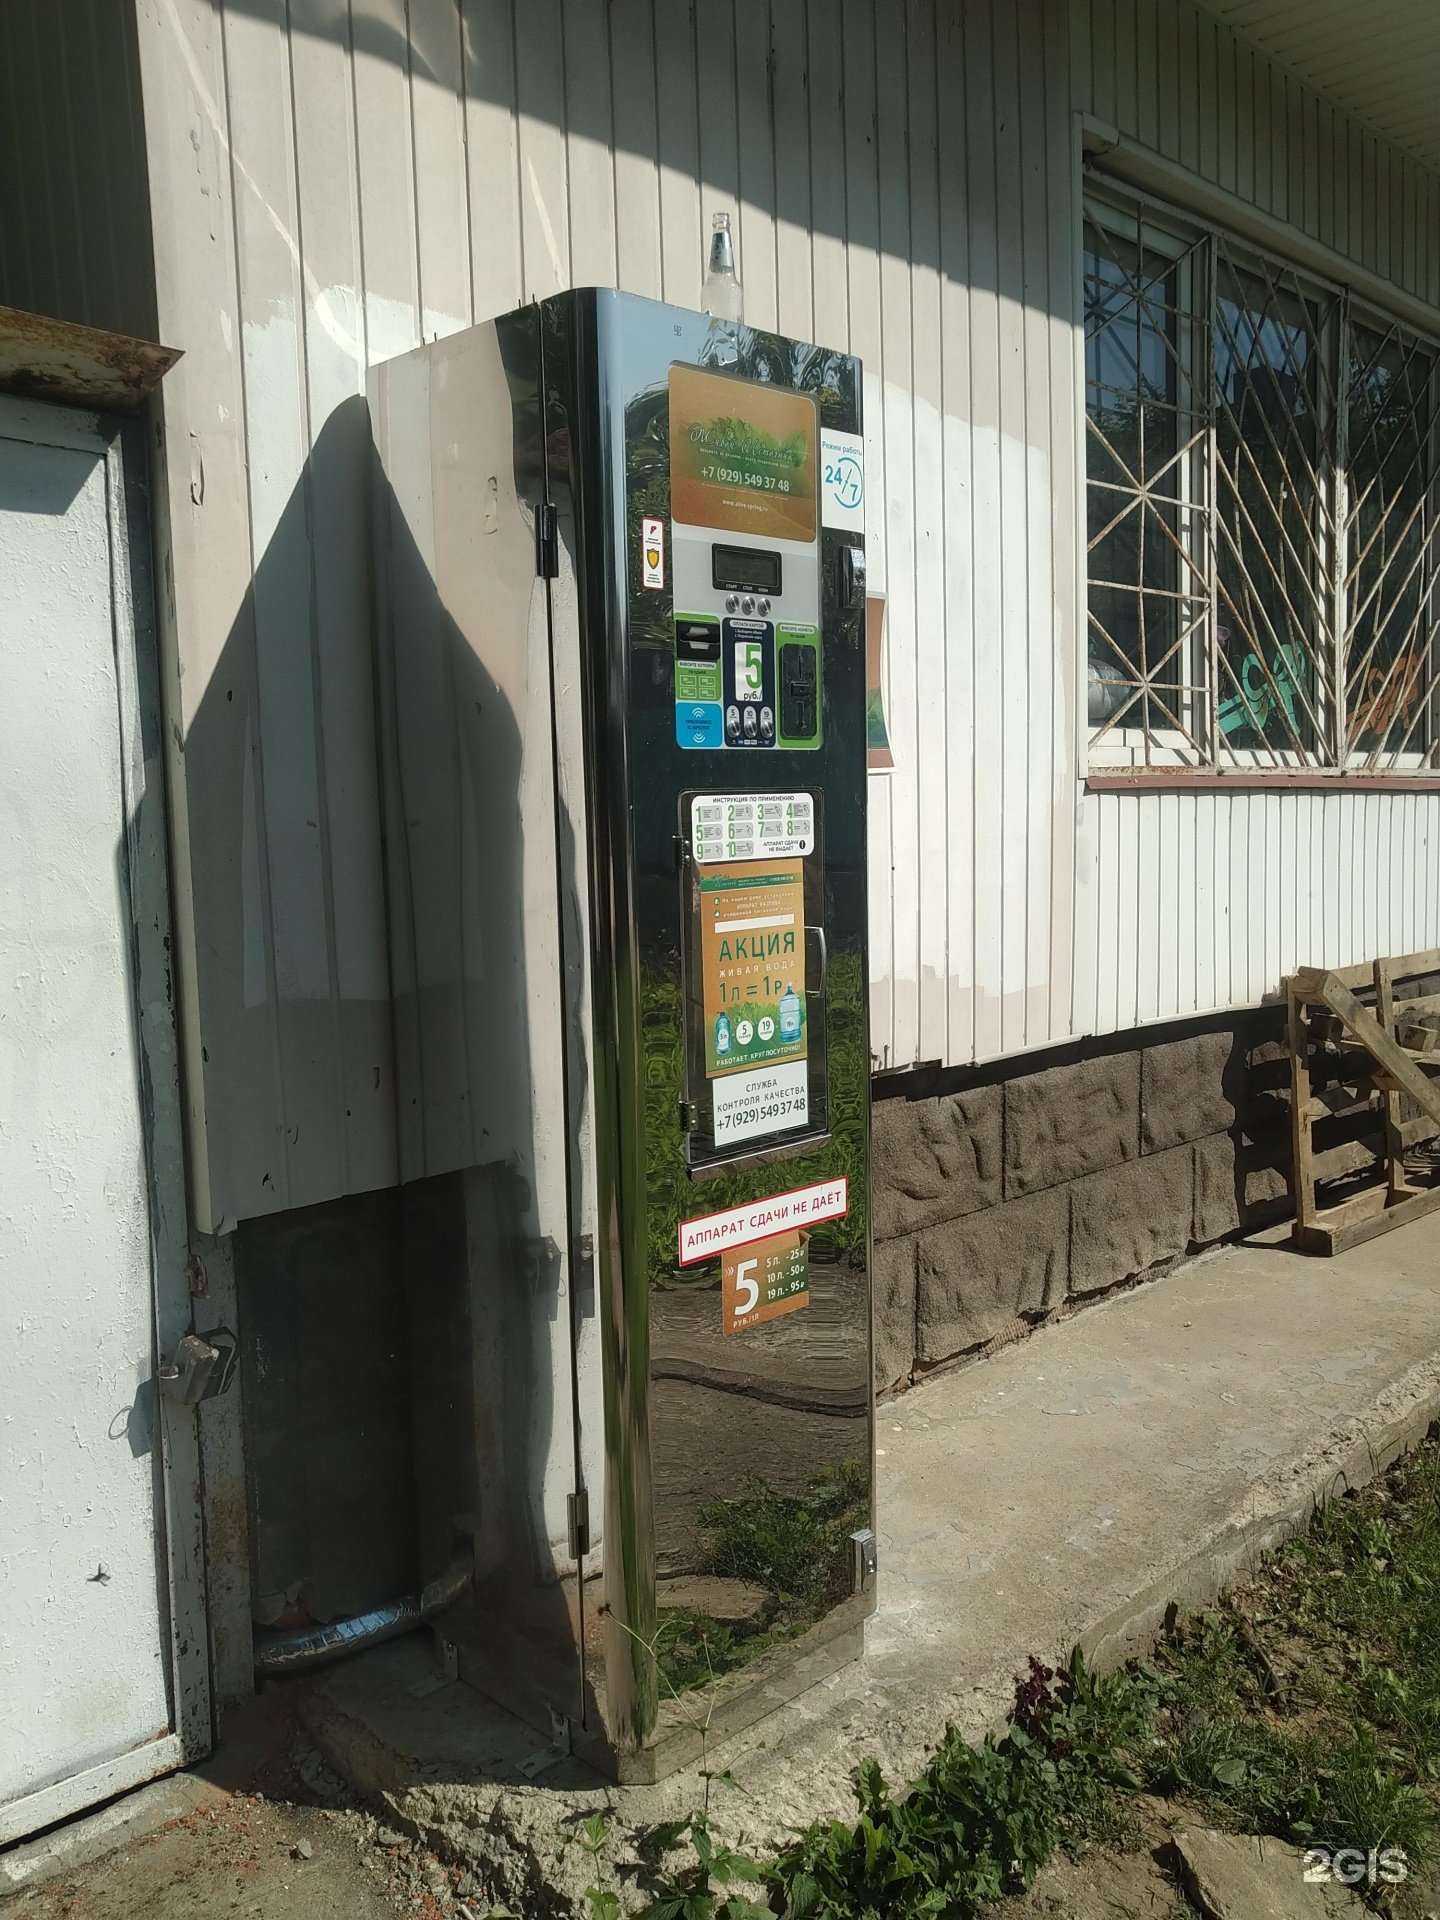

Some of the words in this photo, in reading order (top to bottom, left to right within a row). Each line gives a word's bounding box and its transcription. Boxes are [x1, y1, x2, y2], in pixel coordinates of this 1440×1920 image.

[717, 467, 742, 485] (929)
[777, 480, 790, 492] 48
[745, 644, 762, 688] 5
[727, 804, 735, 821] 2
[757, 803, 765, 819] 3
[786, 802, 793, 818] 4
[696, 824, 703, 841] 5
[728, 822, 736, 839] 6
[757, 821, 765, 838] 7
[786, 820, 794, 836] 8
[696, 843, 703, 860] 9
[726, 841, 737, 858] 10
[719, 931, 795, 962] АКЦИЯ
[719, 965, 759, 978] ЖИВАЯ
[742, 1024, 748, 1035] 5
[762, 1020, 771, 1031] 19
[716, 1055, 748, 1067] РАБОТАЕТ
[745, 1079, 778, 1092] СЛУЖБА
[717, 1096, 760, 1112] КОНТРОЛЯ
[764, 1086, 805, 1102] КАЧЕСТВА
[687, 1219, 745, 1248] АППАРАТ
[750, 1206, 789, 1229] СДАЧИ
[793, 1201, 807, 1216] НЕ
[812, 1191, 842, 1212] ДАЁТ
[734, 1258, 759, 1316] 5
